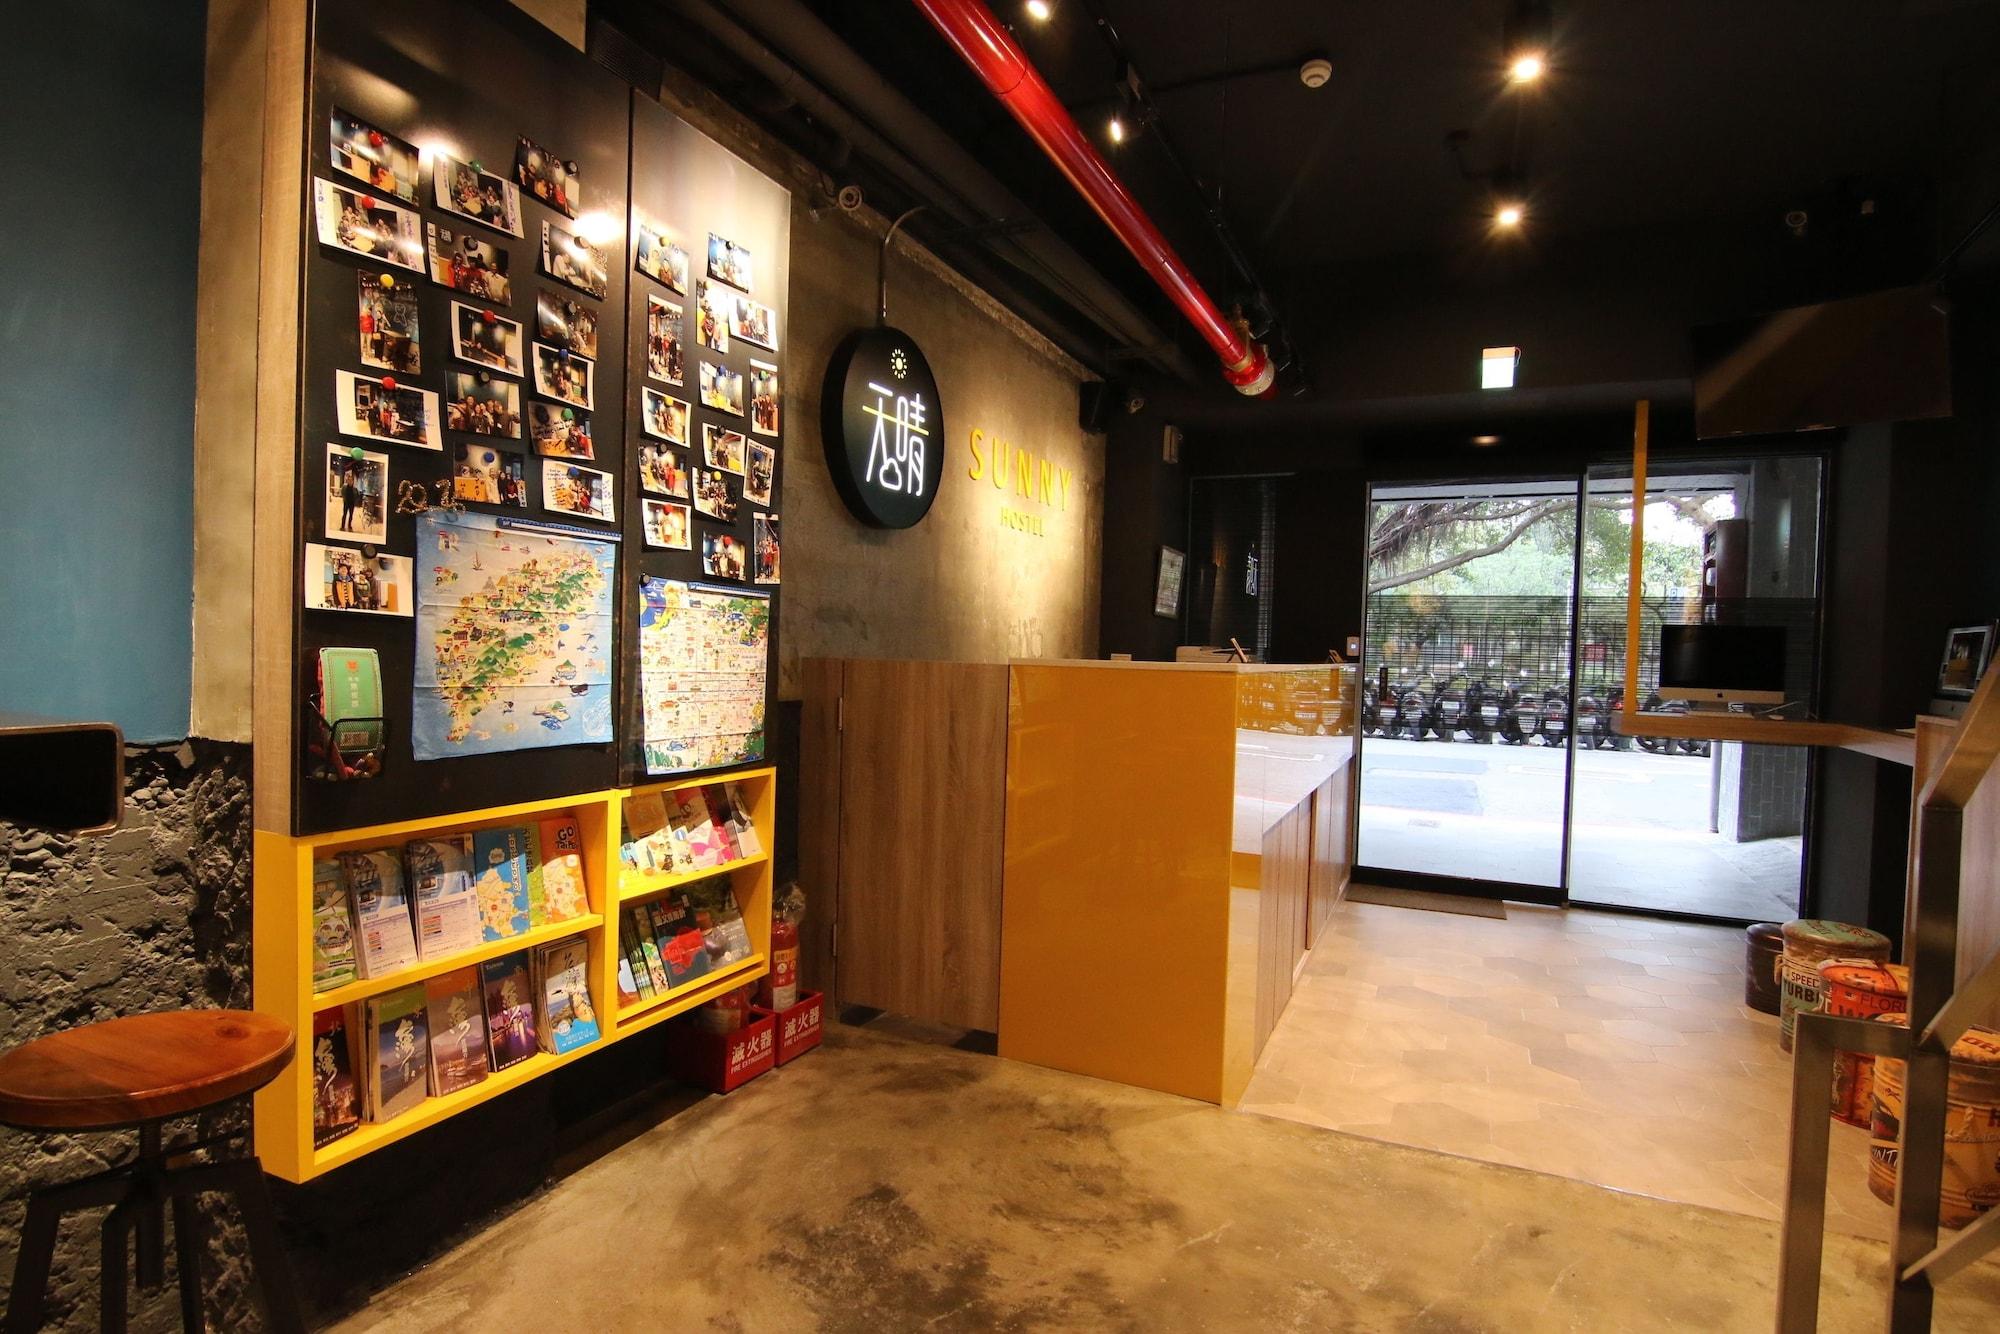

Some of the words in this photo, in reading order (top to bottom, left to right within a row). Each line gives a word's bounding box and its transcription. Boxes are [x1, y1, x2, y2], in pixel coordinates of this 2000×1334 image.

[968, 428, 1073, 511] SUNNY
[1000, 507, 1045, 538] HOSTEL
[558, 826, 574, 841] GO
[784, 1005, 820, 1038] 滅火器
[731, 1028, 773, 1065] 滅火器
